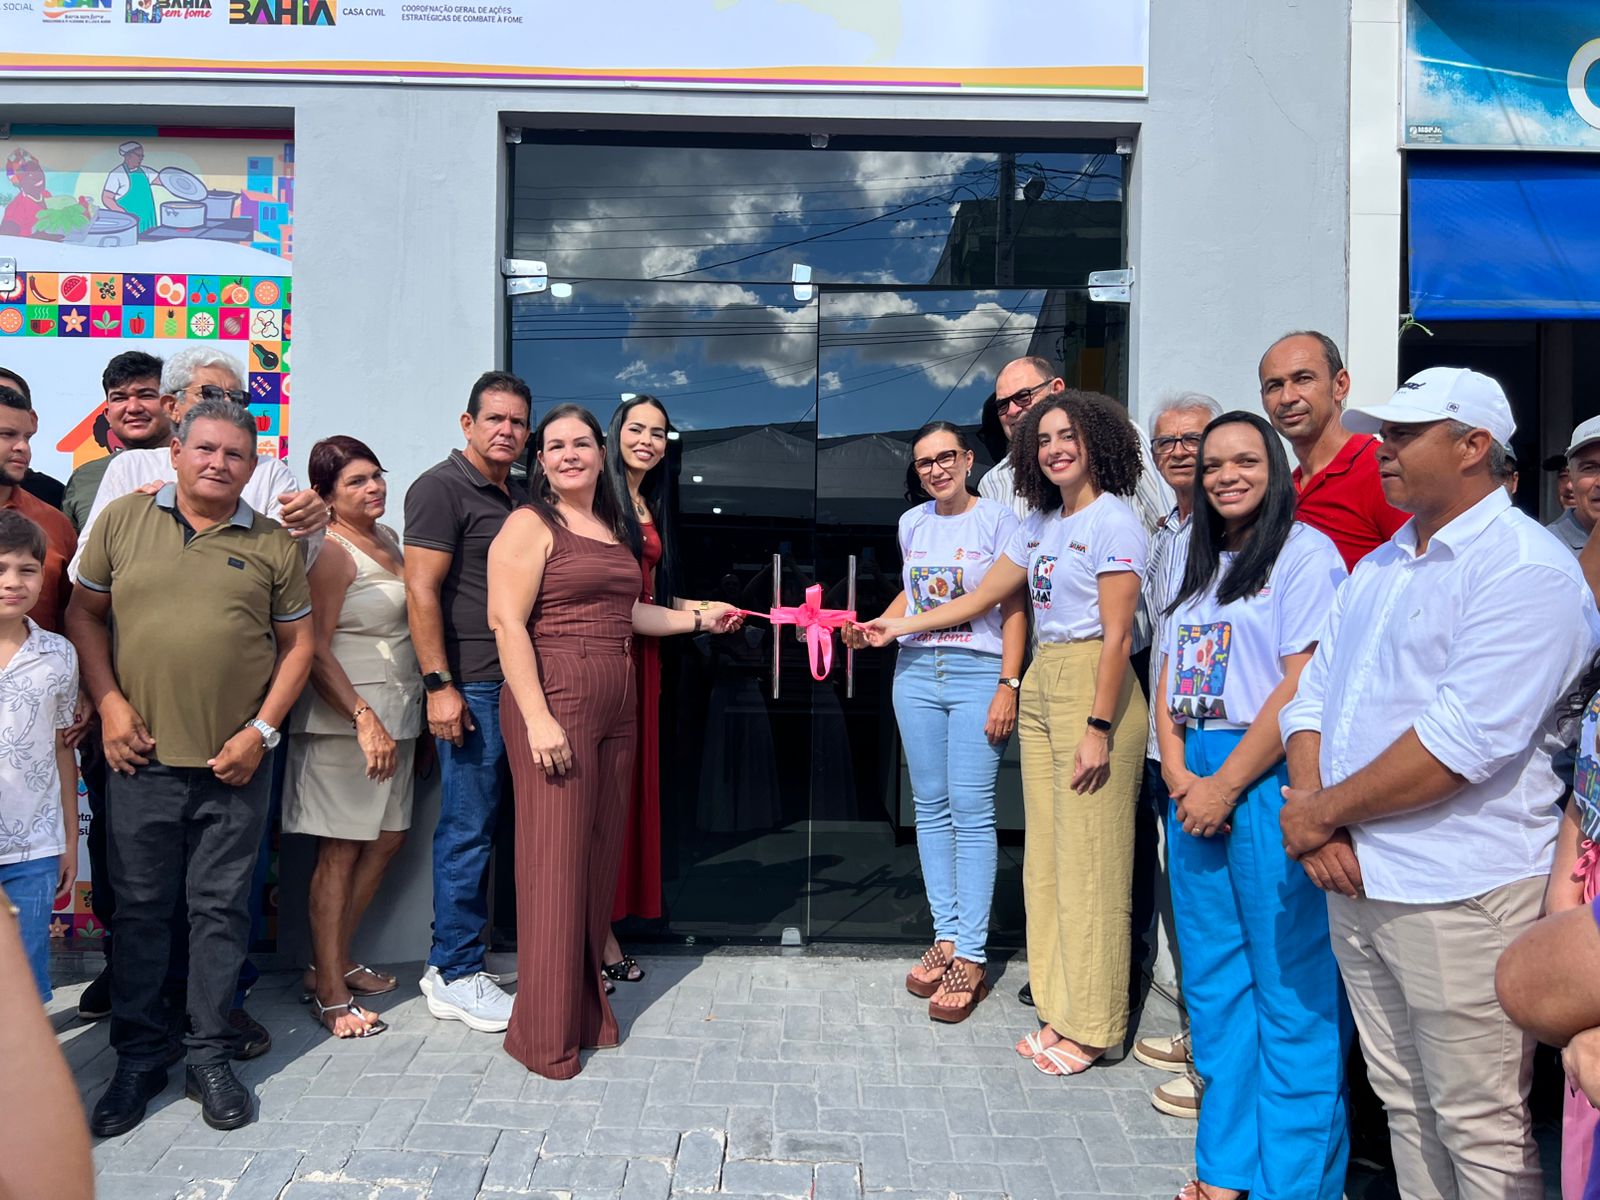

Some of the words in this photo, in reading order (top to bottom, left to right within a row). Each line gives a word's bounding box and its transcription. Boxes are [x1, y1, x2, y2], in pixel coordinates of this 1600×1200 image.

[3, 3, 35, 11] SOCIAL
[488, 6, 512, 15] AÇÕES
[184, 8, 213, 19] fome
[229, 0, 336, 26] BAHIA
[342, 8, 364, 16] CASA
[365, 8, 386, 17] CIVIL
[463, 15, 496, 23] COMBATE
[503, 16, 524, 24] FOME
